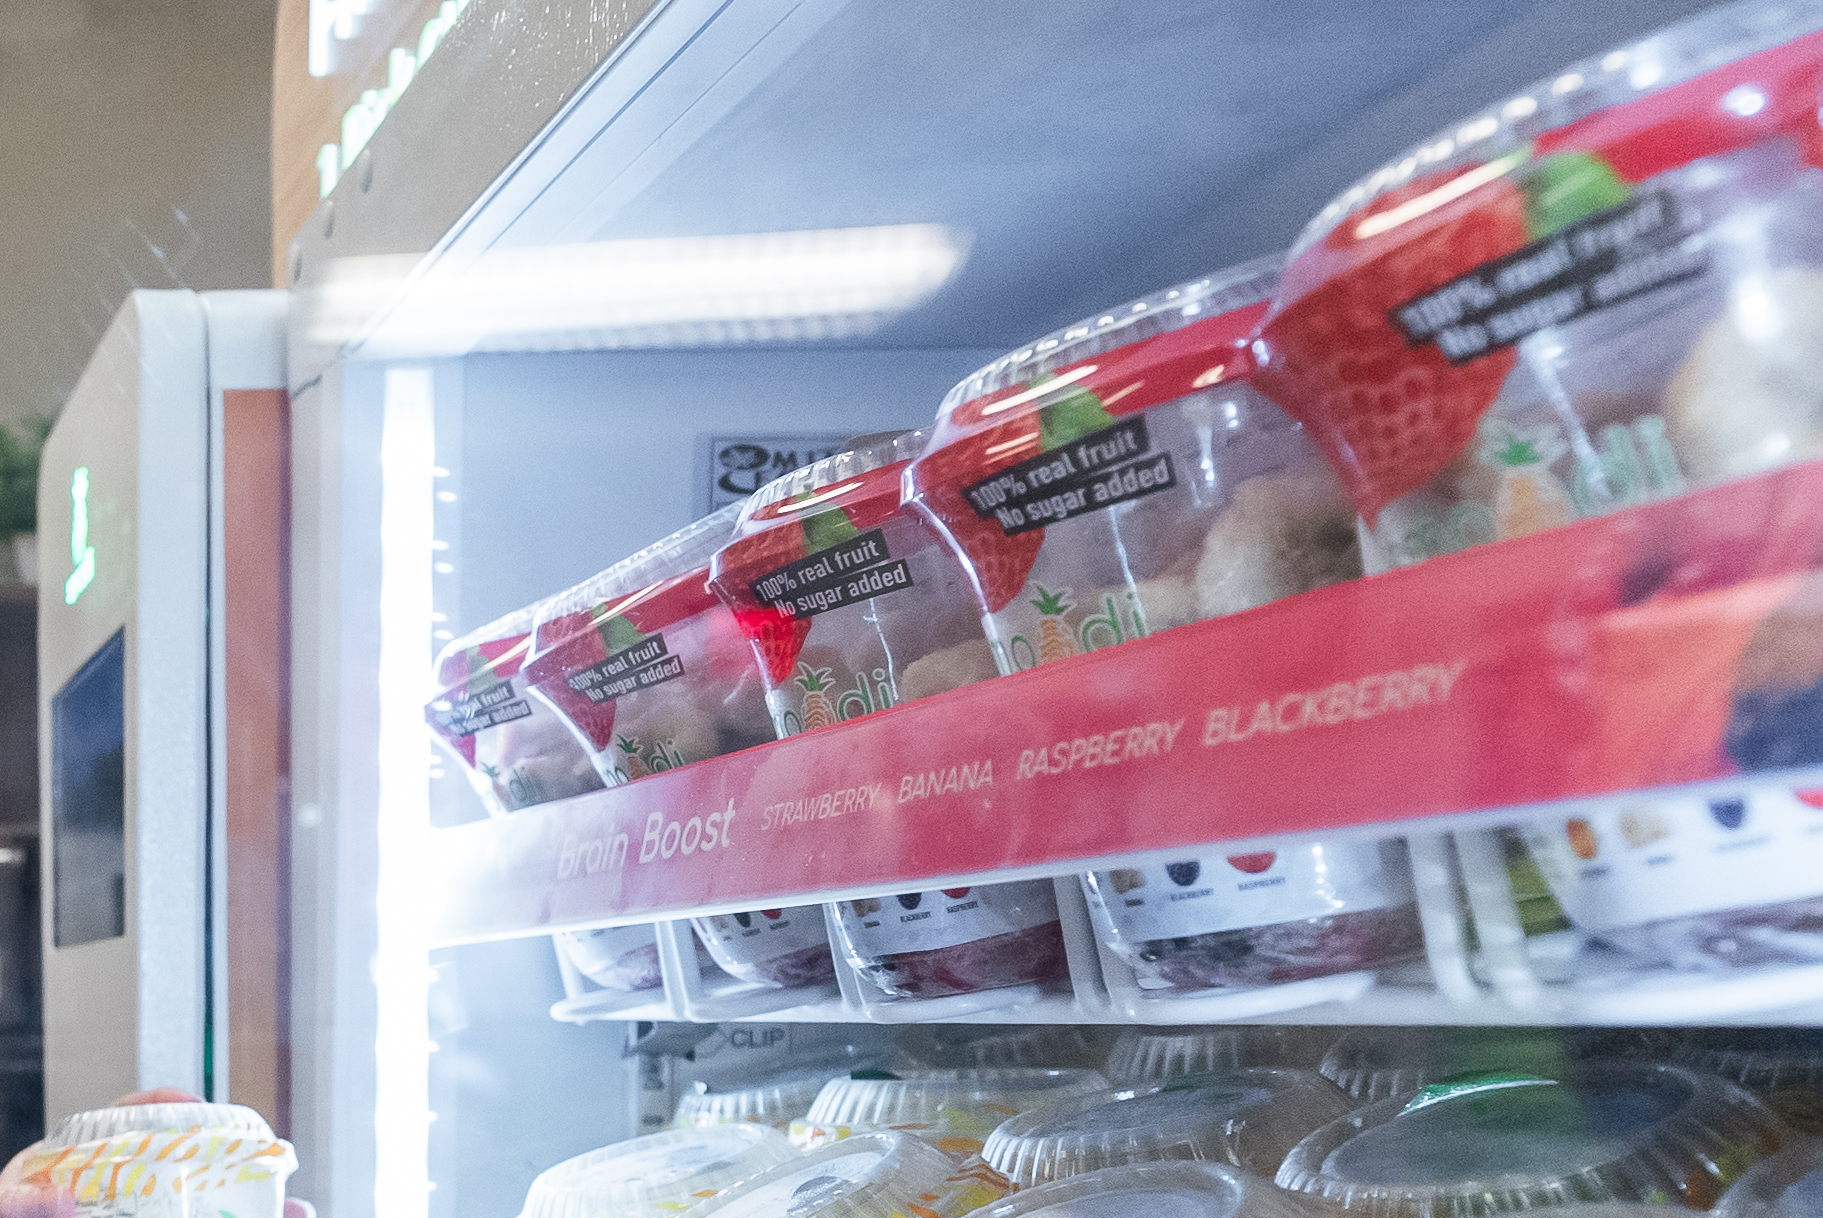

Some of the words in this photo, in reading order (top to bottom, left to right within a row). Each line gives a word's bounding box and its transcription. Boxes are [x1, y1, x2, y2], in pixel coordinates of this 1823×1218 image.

[972, 474, 1026, 509] 100%
[1028, 453, 1076, 488] real
[1077, 431, 1138, 468] fruit
[995, 506, 1025, 528] No
[1027, 487, 1086, 521] sugar
[1093, 459, 1171, 501] added
[756, 571, 797, 602] 100%
[798, 558, 834, 585] real
[834, 540, 880, 570] fruit
[774, 597, 796, 619] No
[798, 585, 843, 610] sugar
[848, 564, 907, 597] added
[585, 684, 604, 702] No
[604, 675, 637, 697] sugar
[641, 660, 682, 684] added
[603, 660, 628, 679] real
[628, 641, 662, 665] fruit
[557, 824, 629, 879] Brain
[639, 798, 736, 865] Boost
[761, 783, 882, 831] STRAWBERRY
[898, 760, 994, 803] BANANA
[1016, 718, 1184, 780] RASPBERRY
[1203, 658, 1468, 747] BLACKBERRY
[730, 1027, 786, 1050] CLIP
